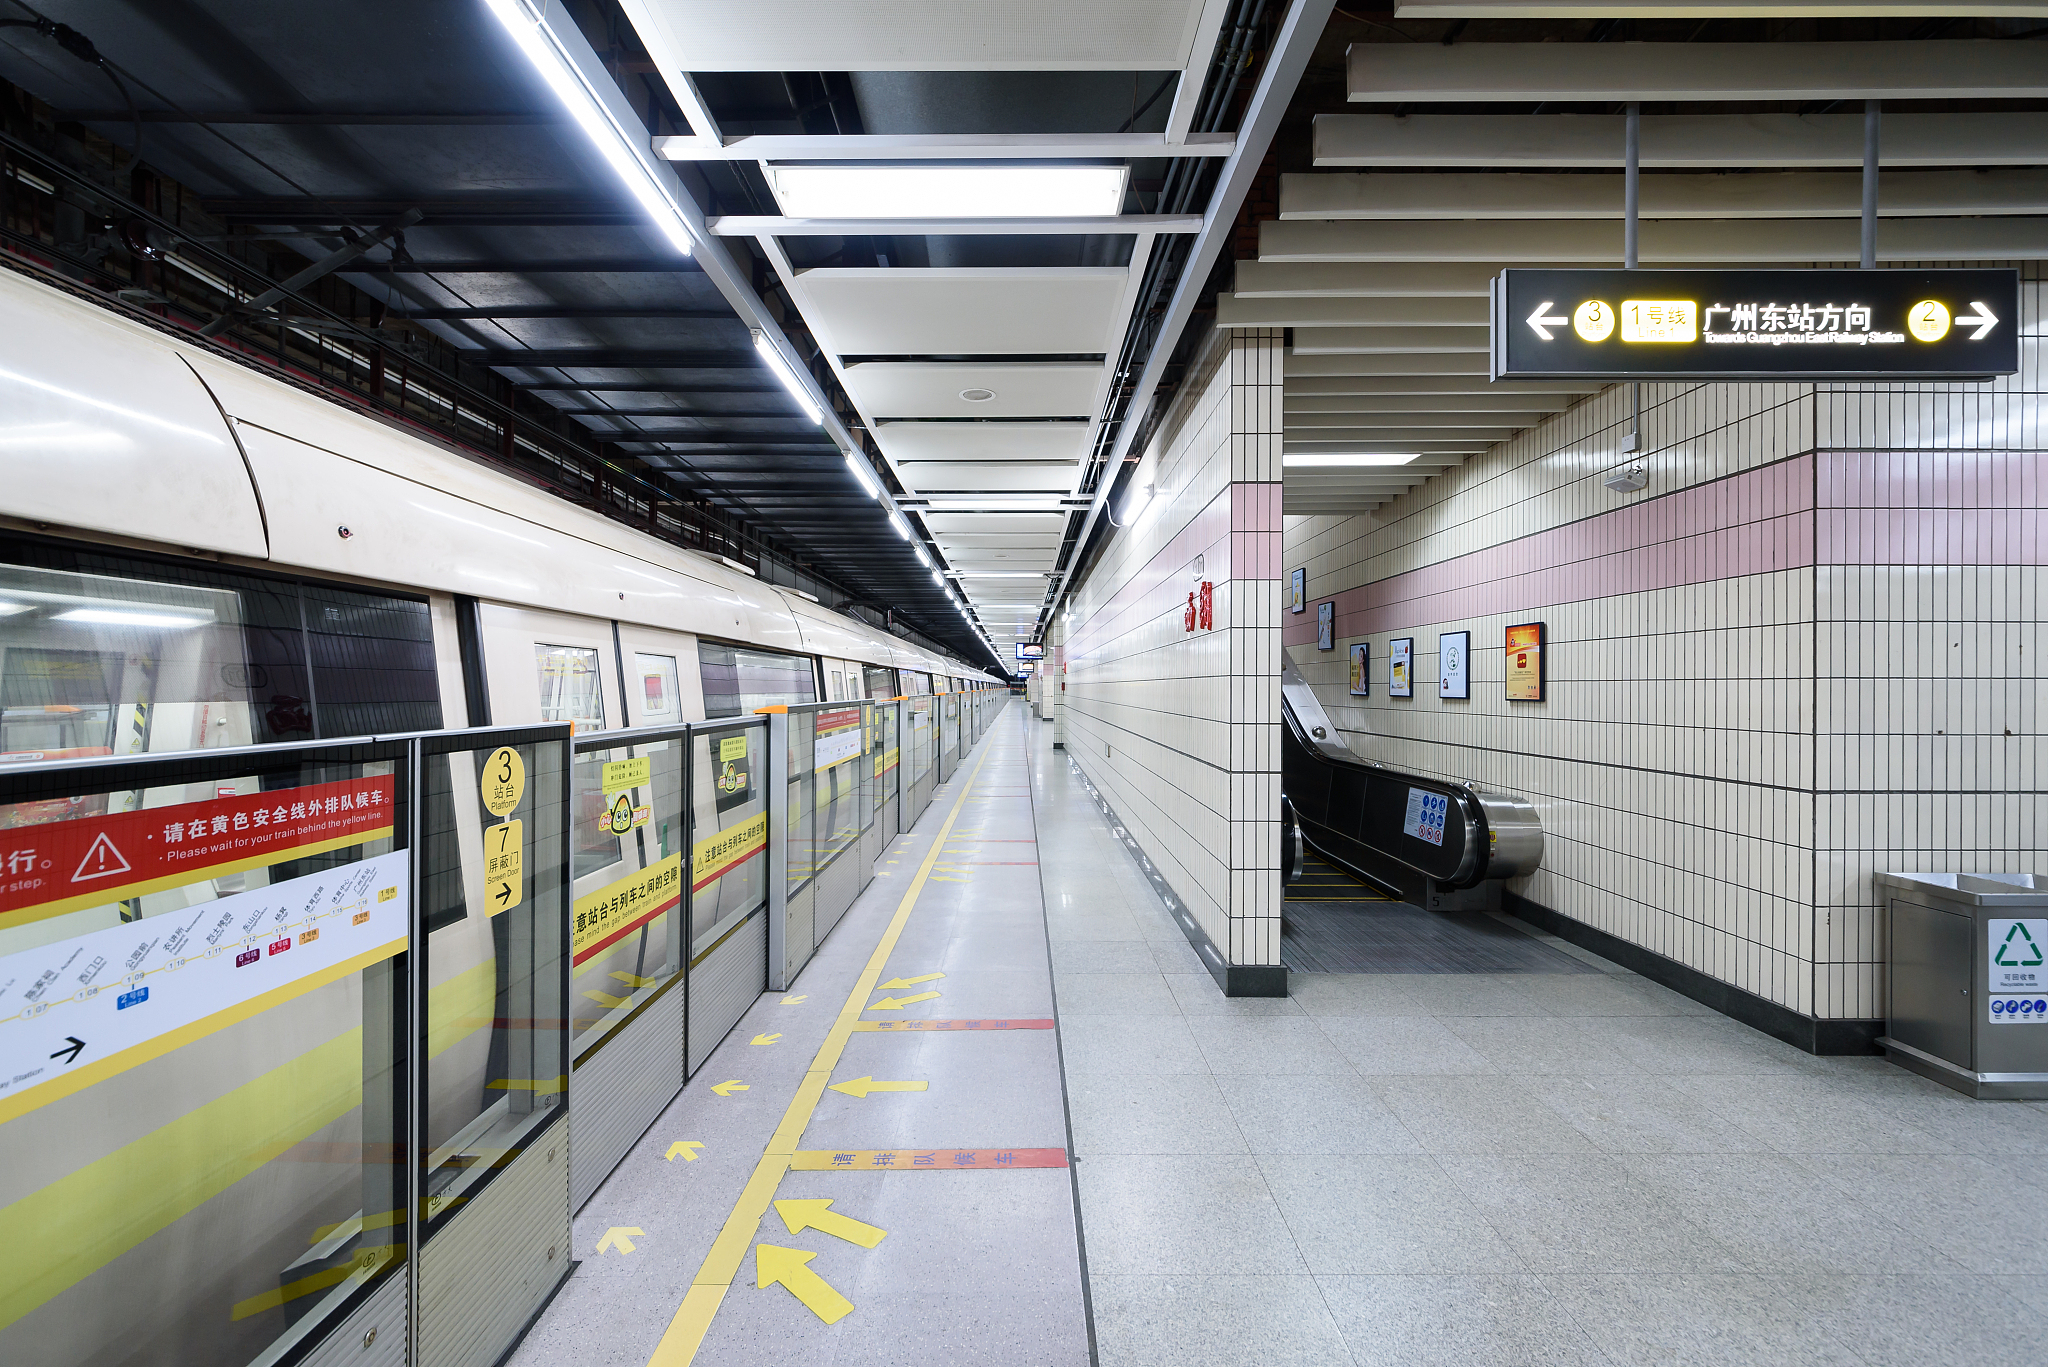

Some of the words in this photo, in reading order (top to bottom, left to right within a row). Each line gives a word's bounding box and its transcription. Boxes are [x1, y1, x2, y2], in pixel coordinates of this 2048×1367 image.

[1588, 301, 1601, 321] 3
[1631, 305, 1686, 325] 1号线
[1703, 303, 1872, 331] 广州东站方向
[1922, 301, 1936, 321] 2
[1638, 327, 1665, 337] Line
[1703, 331, 1746, 343] Towards
[1747, 331, 1805, 345] Guangzhou
[1805, 331, 1827, 343] East
[1827, 331, 1868, 345] Railway
[1868, 331, 1905, 343] Station
[498, 750, 512, 783] 3
[494, 783, 515, 800] 站台
[491, 799, 517, 811] Platform
[163, 789, 389, 844] 请在黄色安全线外排队候车。
[167, 846, 208, 861] Please
[210, 839, 233, 853] wait
[235, 836, 248, 848] for
[250, 833, 273, 847] your
[275, 828, 295, 840] train
[297, 821, 326, 835] behind
[328, 820, 340, 830] the
[342, 814, 366, 829] yellow
[368, 811, 383, 823] line.
[498, 826, 509, 852] 7
[0, 848, 52, 877] 行。
[488, 850, 519, 873] 屏蔽门
[9, 878, 47, 892] step.
[487, 872, 506, 885] Screen
[507, 867, 519, 878] Door
[1432, 896, 1440, 907] 5
[586, 926, 600, 939] mind
[602, 921, 610, 931] the
[611, 915, 621, 928] gap
[622, 904, 641, 919] between
[2004, 973, 2036, 981] 可回收物
[120, 989, 146, 1003] 2号线
[831, 1151, 1018, 1167] 请排队候车
